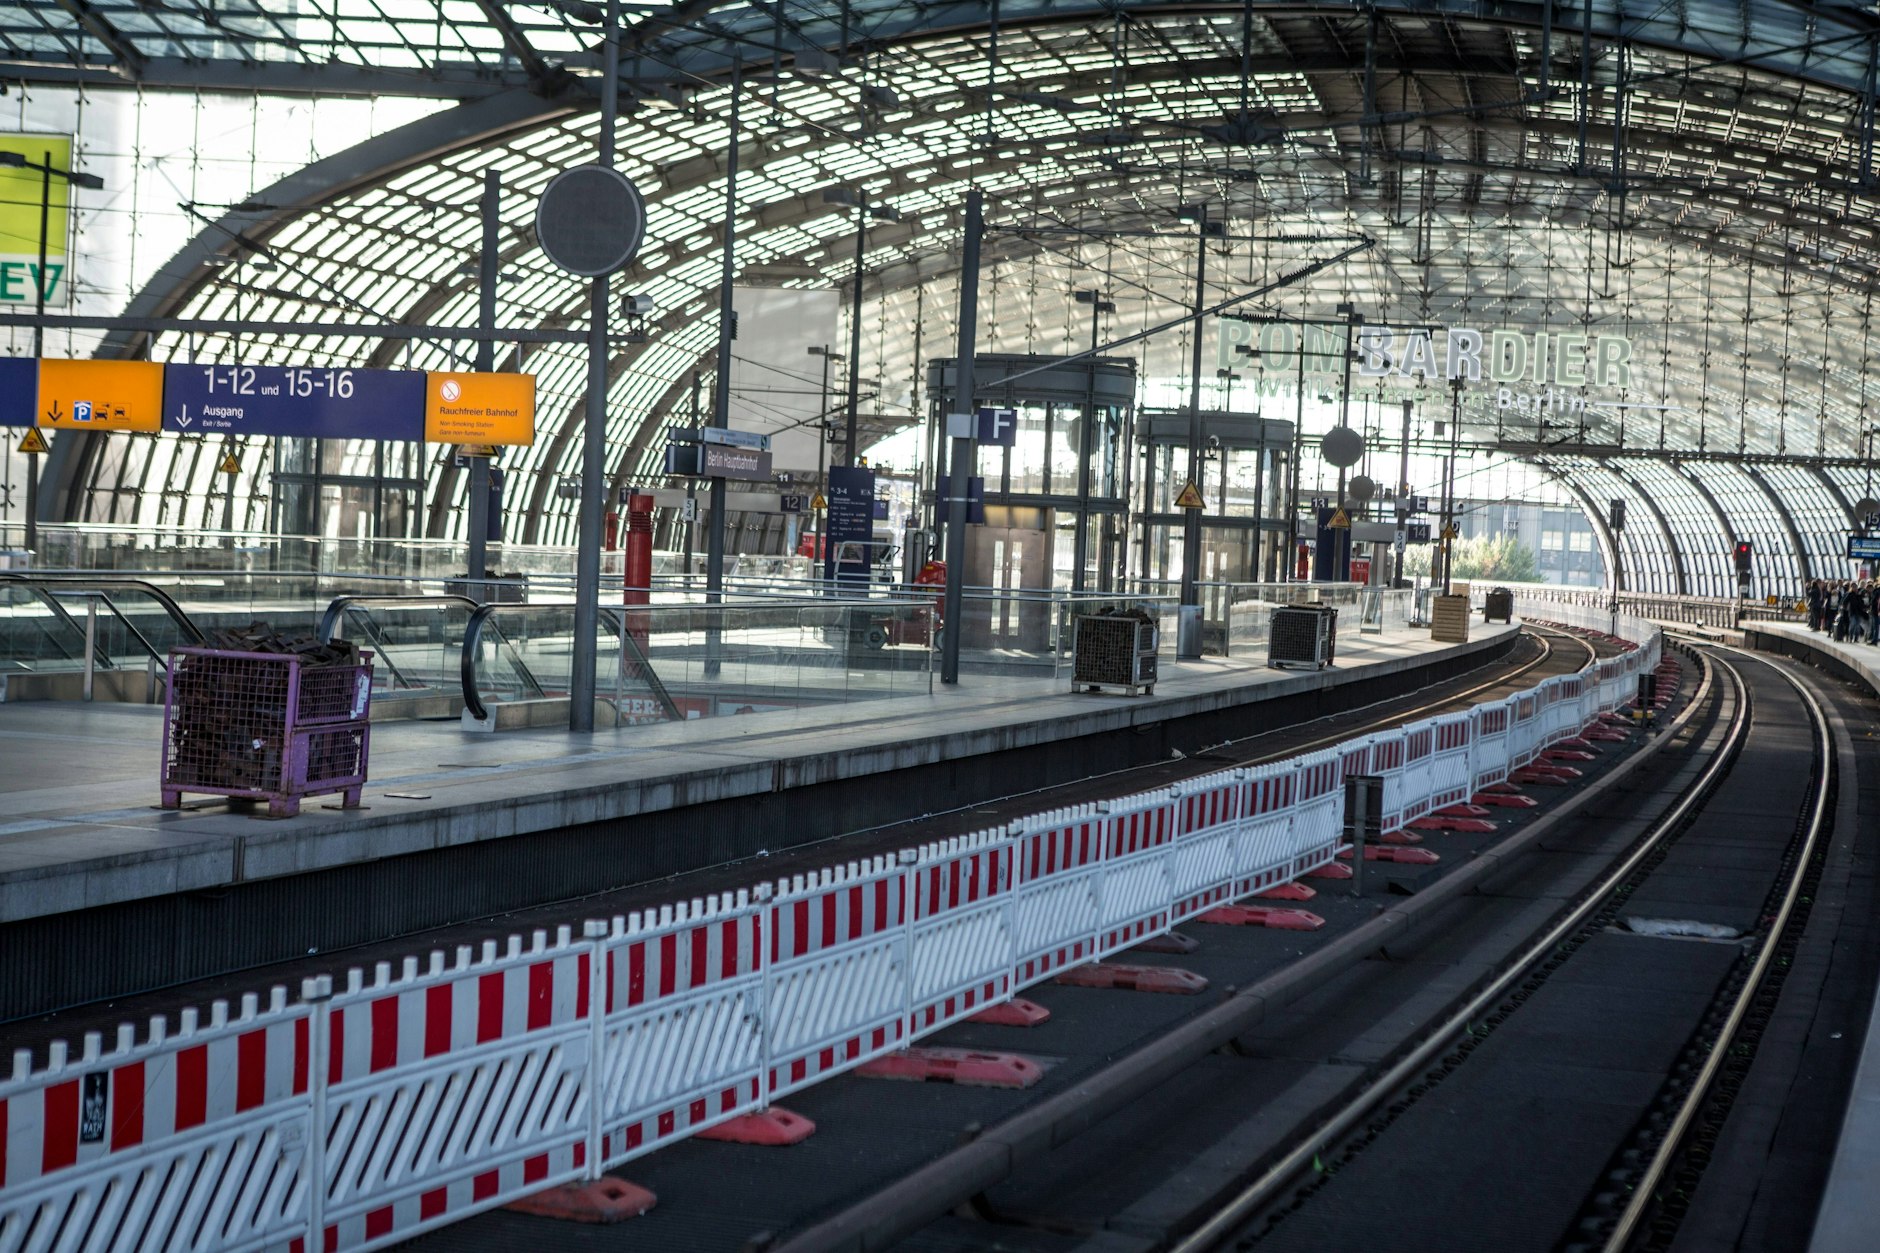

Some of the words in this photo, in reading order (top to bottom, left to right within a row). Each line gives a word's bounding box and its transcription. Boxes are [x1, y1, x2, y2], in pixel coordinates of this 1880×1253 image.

[1217, 318, 1633, 388] BOMBARDIER
[204, 366, 256, 395] 1-12
[261, 385, 280, 396] und
[284, 369, 354, 399] 15-16
[1498, 386, 1586, 413] Berlin
[202, 404, 244, 419] Ausgang
[439, 406, 483, 416] Rauchfreier
[485, 408, 518, 417] Bahnhof
[993, 409, 1012, 439] F
[707, 450, 723, 467] Berlin
[723, 452, 758, 472] Hauptbahnhof
[784, 496, 799, 509] 12
[1312, 498, 1325, 508] 13
[1416, 496, 1426, 510] E
[1412, 526, 1426, 539] 14
